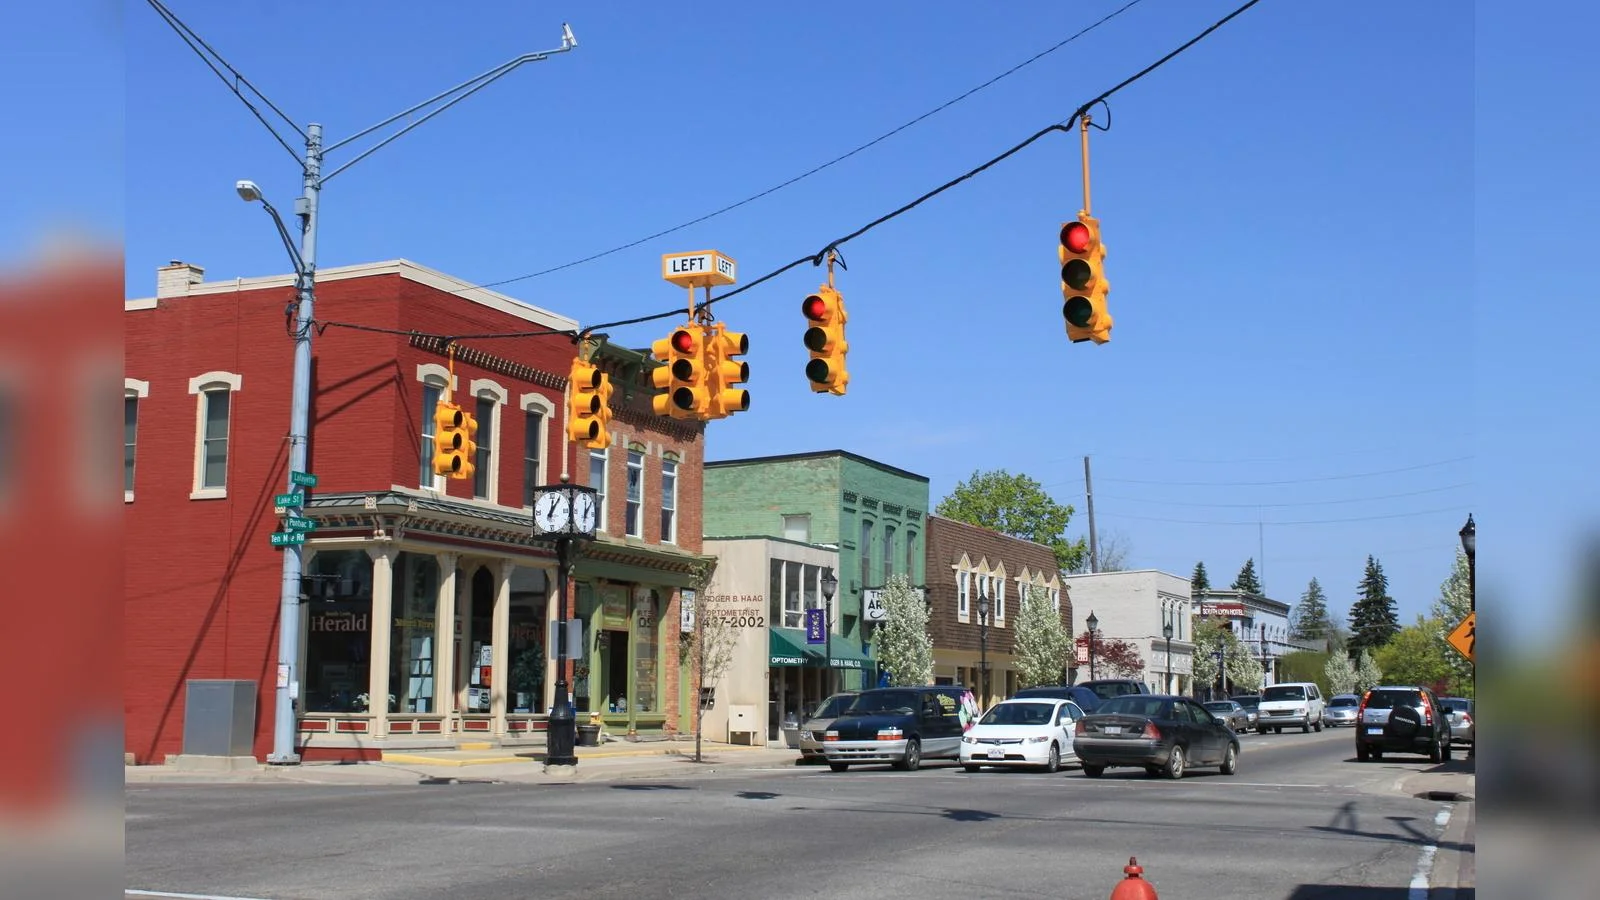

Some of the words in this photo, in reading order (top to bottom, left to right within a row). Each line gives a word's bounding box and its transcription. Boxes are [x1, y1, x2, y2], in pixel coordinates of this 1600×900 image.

[673, 257, 705, 272] LEFT
[718, 258, 732, 277] LEFT
[277, 496, 291, 505] Lake
[292, 495, 300, 503] St
[289, 518, 307, 528] Pontiac
[271, 534, 281, 543] Ten
[283, 533, 295, 542] Me
[296, 533, 304, 541] Rd
[741, 594, 763, 602] HAAG
[1230, 608, 1244, 616] HOTEL
[312, 613, 368, 631] Herald
[1395, 716, 1416, 724] HONDA
